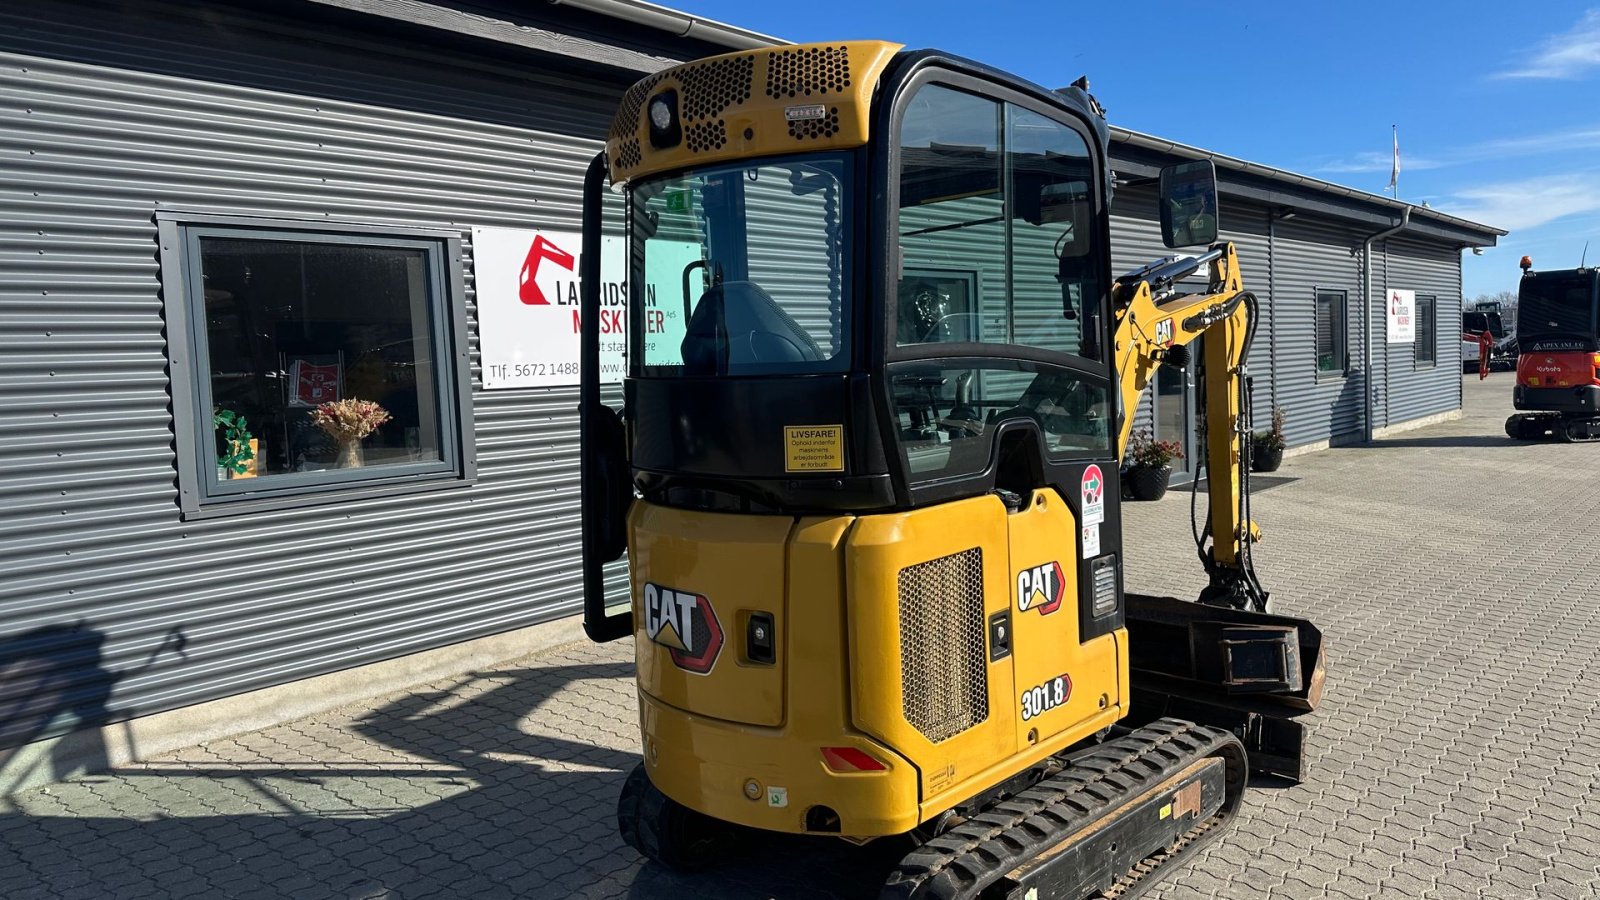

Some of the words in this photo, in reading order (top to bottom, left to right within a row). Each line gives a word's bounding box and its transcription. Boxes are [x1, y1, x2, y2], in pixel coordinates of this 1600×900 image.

[556, 280, 657, 307] LAIDSN
[1156, 318, 1171, 345] CAT
[489, 364, 511, 380] Tlf.
[515, 363, 546, 377] 5672
[549, 362, 579, 376] 1488
[791, 430, 836, 438] LIVSFARE!
[1018, 563, 1054, 612] CAT
[644, 583, 698, 653] CAT
[1021, 676, 1065, 722] 301.8
